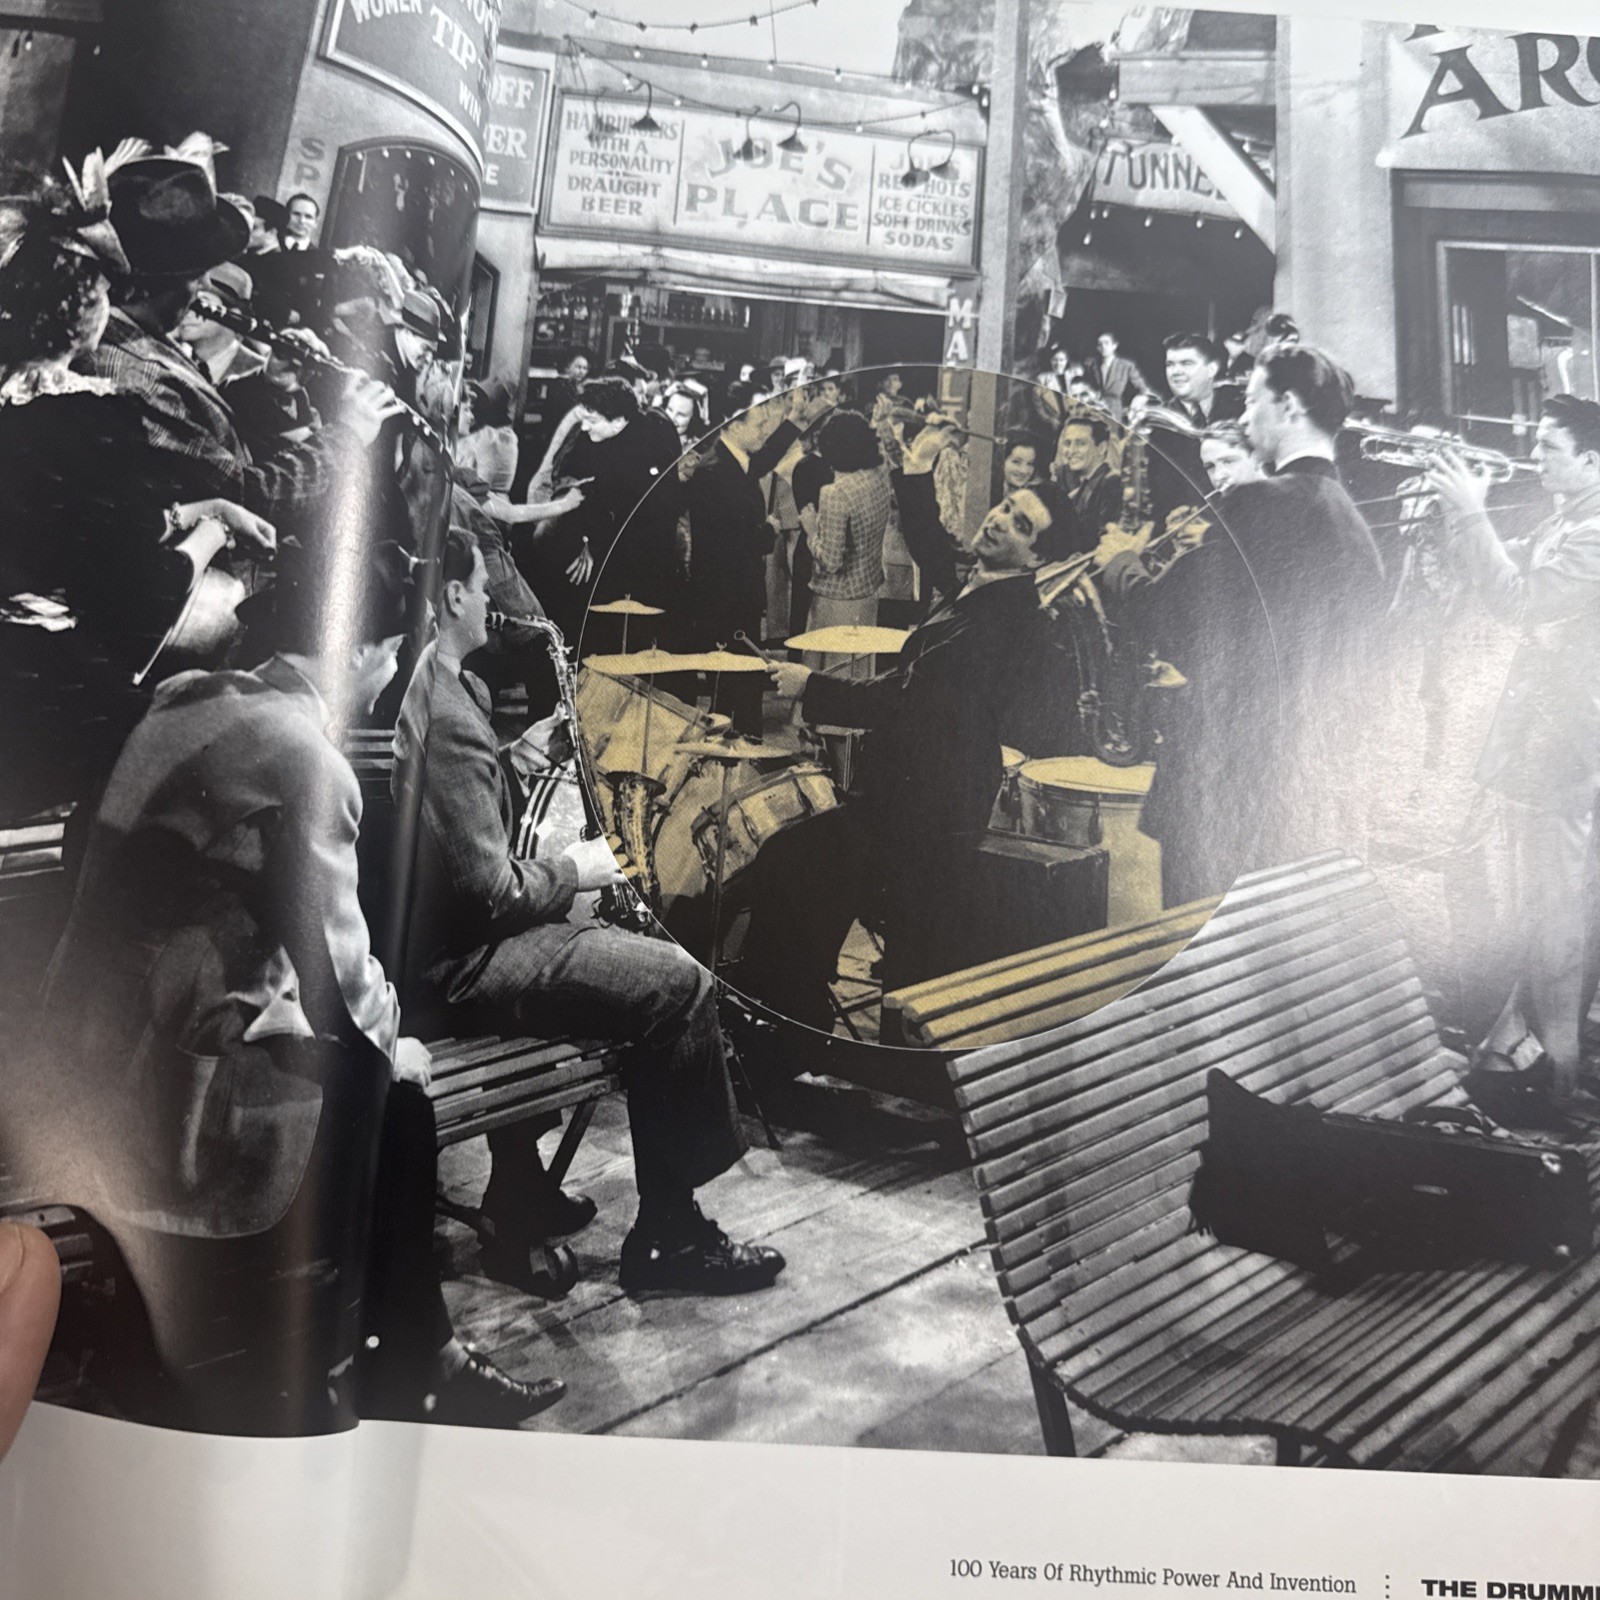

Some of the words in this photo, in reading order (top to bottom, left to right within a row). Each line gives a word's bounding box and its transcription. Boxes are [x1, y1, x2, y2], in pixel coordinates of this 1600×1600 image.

[430, 4, 477, 71] TIP
[491, 73, 535, 109] FF
[1399, 32, 1600, 139] AR
[458, 79, 482, 128] WIN
[483, 123, 528, 160] ER
[634, 139, 649, 156] A
[568, 149, 676, 175] PERSONALITY
[707, 136, 853, 191] JOE'S
[1103, 149, 1228, 202] TUNNE
[567, 175, 662, 199] DRAUGHT
[878, 172, 914, 192] RE
[923, 178, 972, 199] HOTS
[581, 196, 644, 217] BEER
[684, 182, 859, 231] PLACE
[879, 195, 902, 213] ICE
[906, 198, 969, 220] CICKLES
[884, 230, 955, 252] SODAS
[915, 217, 972, 237] DRINKS
[950, 1558, 983, 1578] 100
[988, 1560, 1038, 1580] Years
[1043, 1562, 1064, 1581] Of
[1069, 1564, 1157, 1588] Rhythmic
[1162, 1568, 1221, 1588] Power
[1226, 1570, 1264, 1590] And
[1269, 1572, 1358, 1594] Invention
[1420, 1579, 1478, 1598] THE
